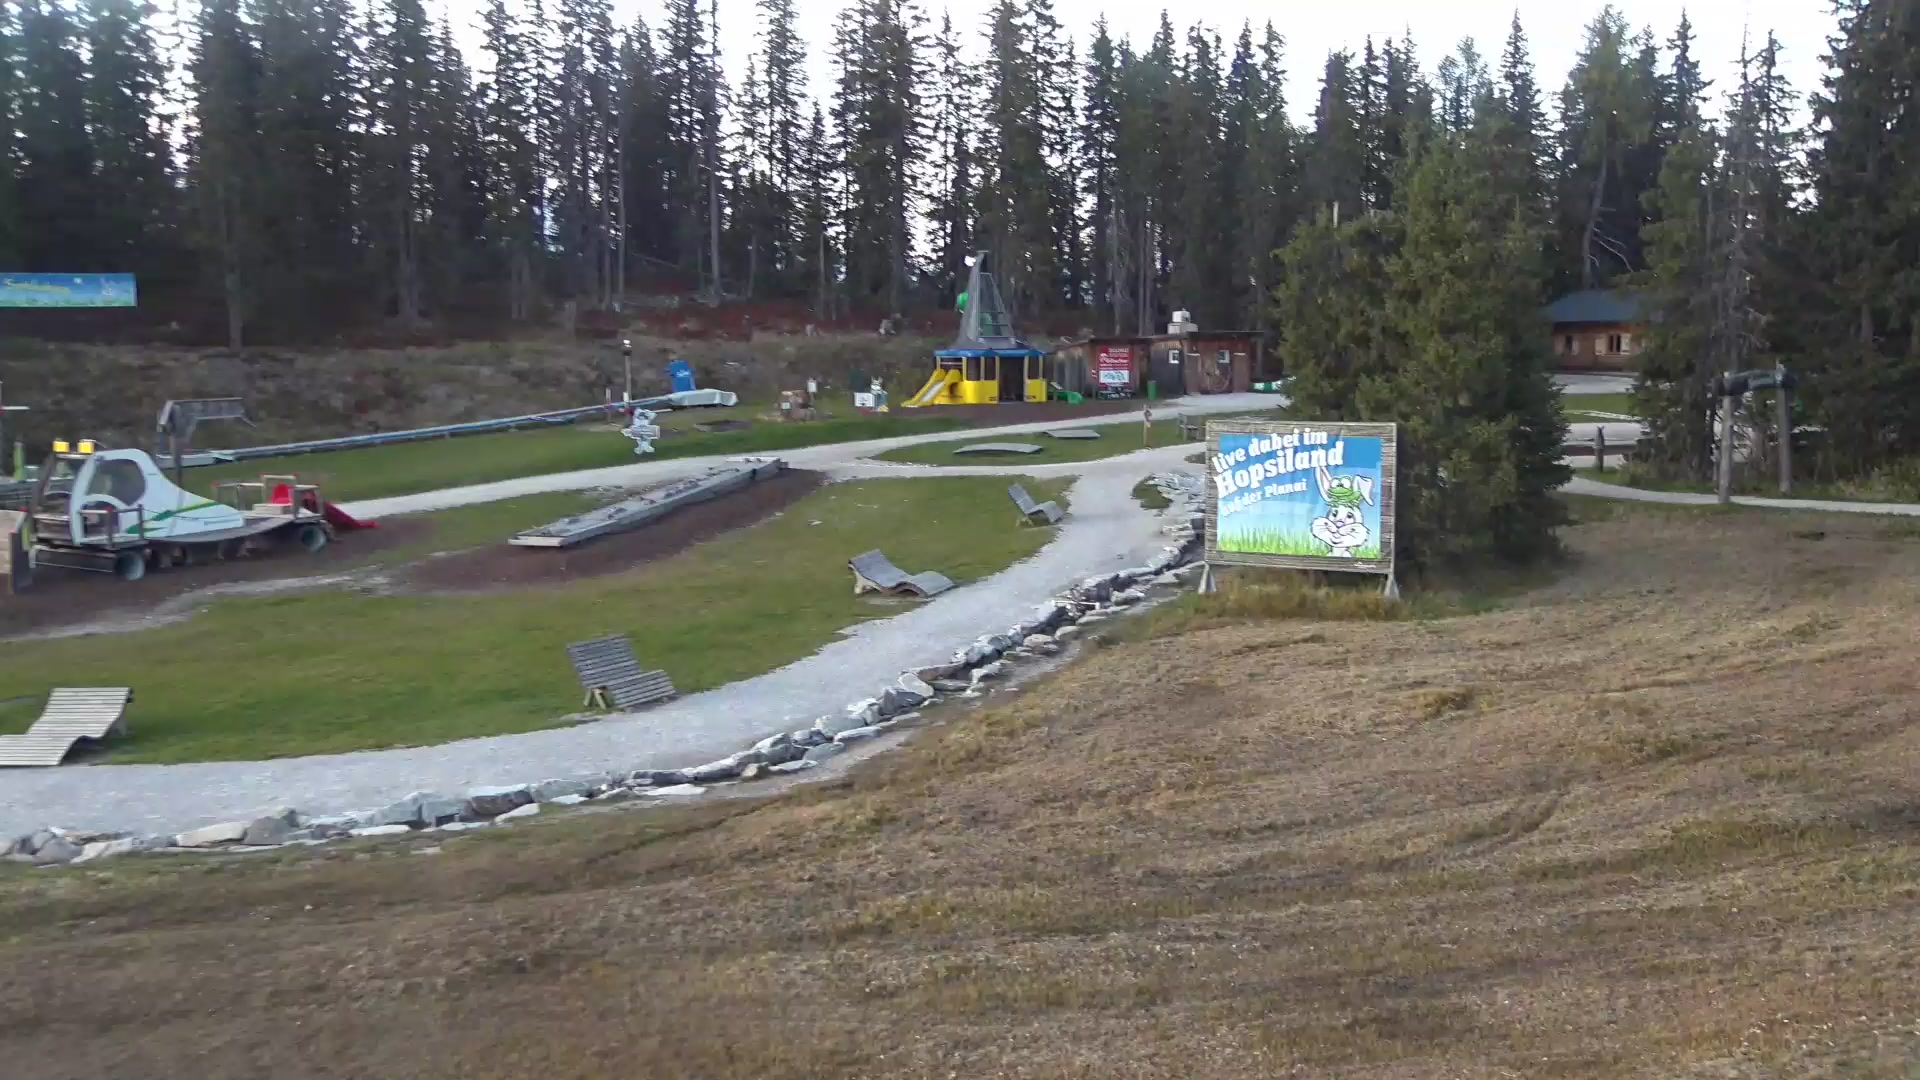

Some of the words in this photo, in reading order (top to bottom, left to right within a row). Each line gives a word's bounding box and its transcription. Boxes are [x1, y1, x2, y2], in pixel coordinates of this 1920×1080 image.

[1212, 448, 1246, 473] live
[1248, 428, 1300, 456] dabei
[1303, 427, 1328, 445] im
[1214, 441, 1344, 498] Hopsiland
[1242, 491, 1262, 506] der
[1264, 479, 1307, 498] Planai
